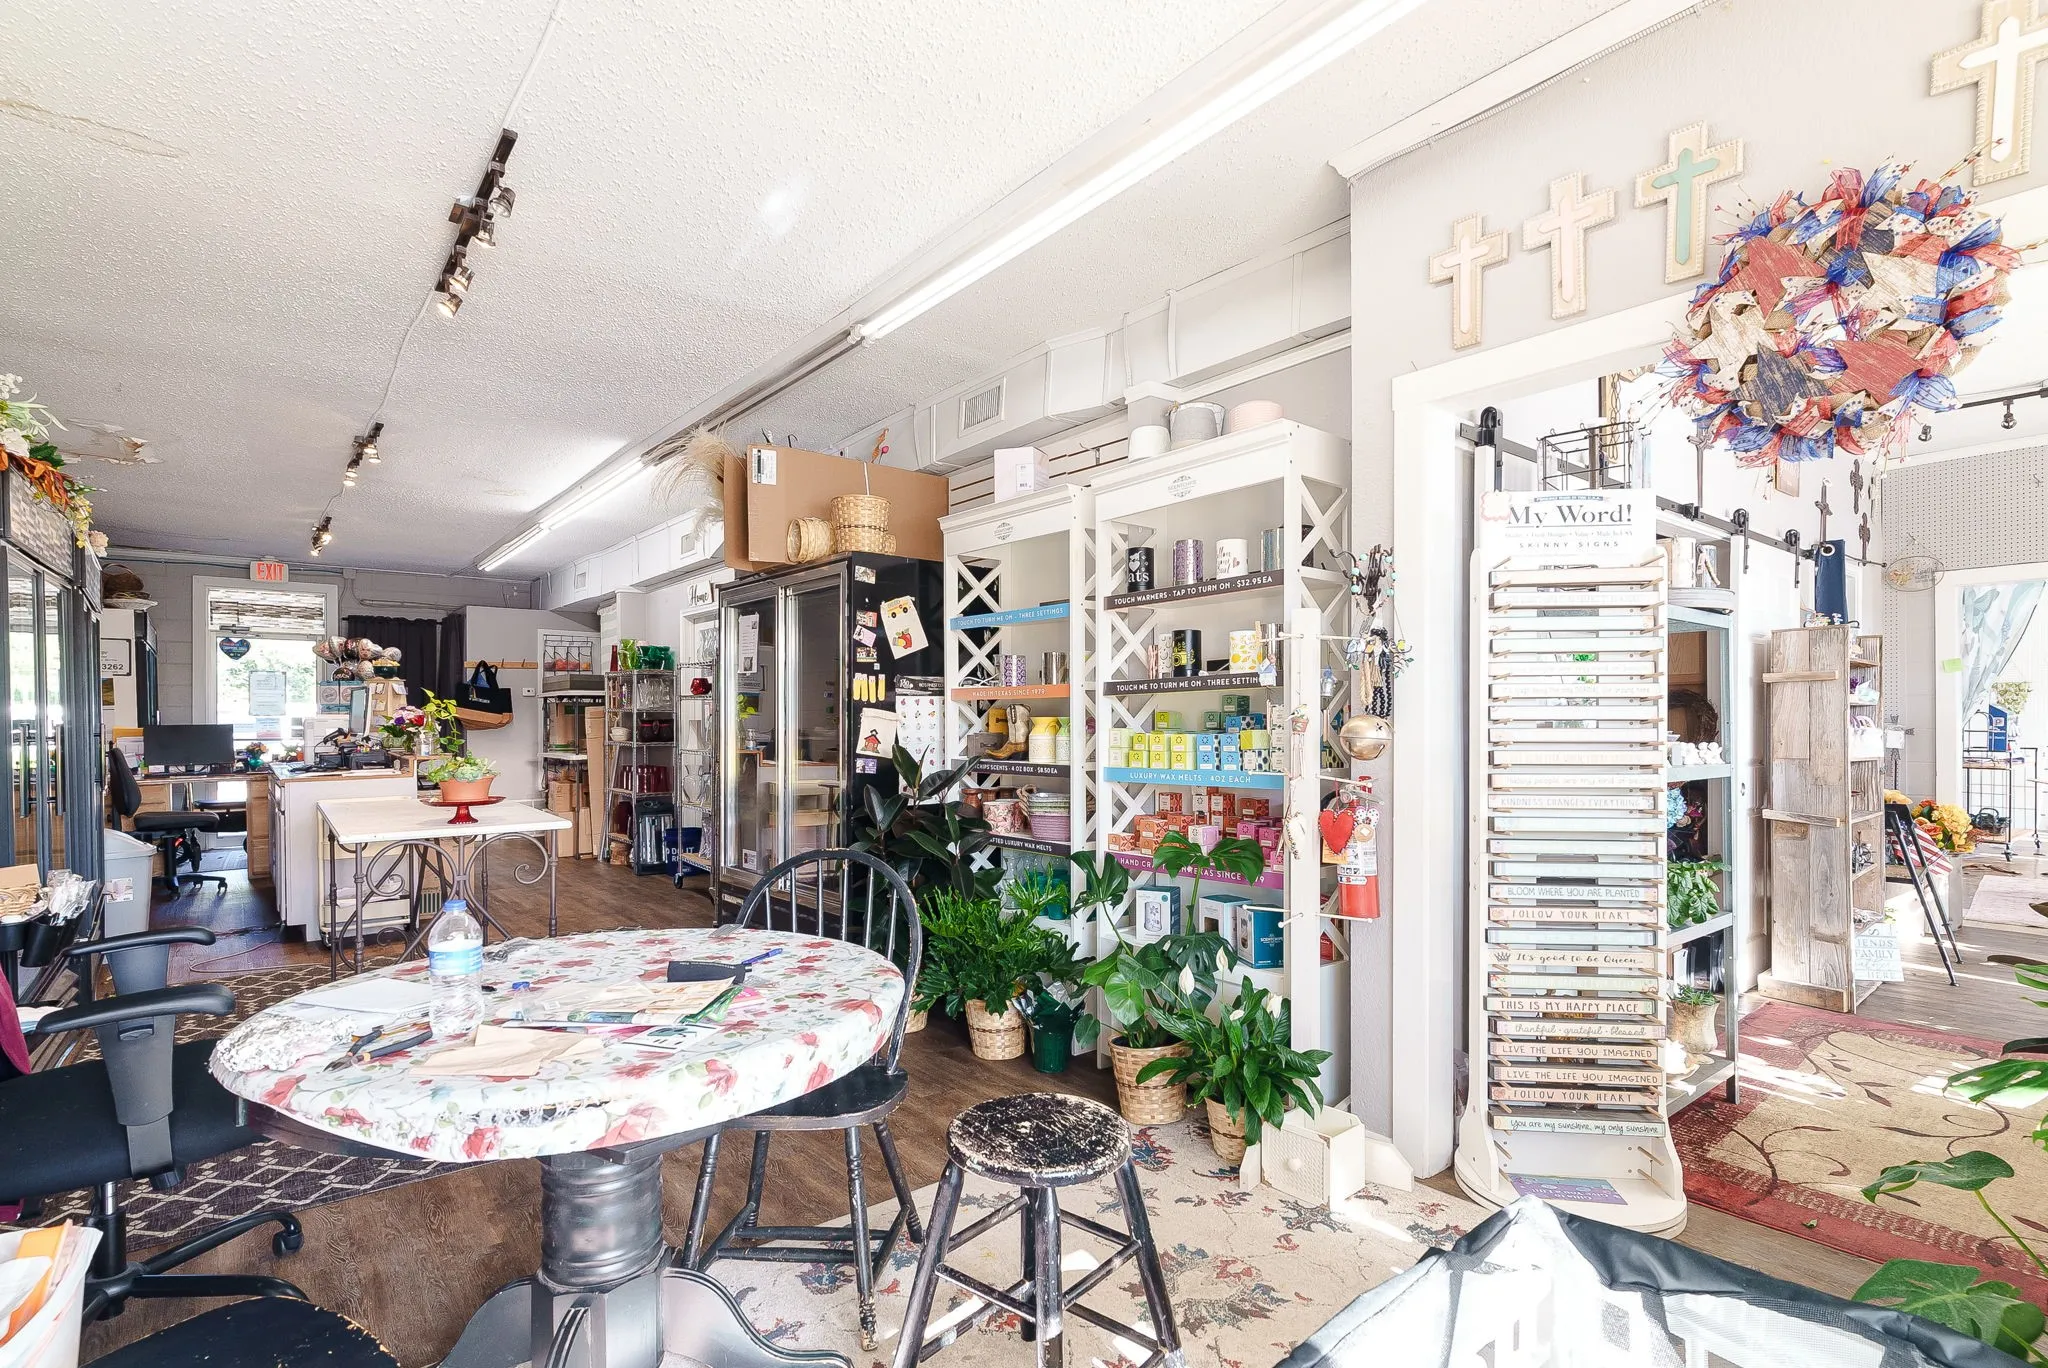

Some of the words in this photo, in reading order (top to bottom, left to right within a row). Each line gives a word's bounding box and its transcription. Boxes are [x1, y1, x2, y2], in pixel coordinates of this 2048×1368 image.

[1508, 505, 1547, 528] My
[1556, 504, 1632, 524] Word!
[256, 562, 284, 580] EXIT
[1128, 572, 1150, 582] ats
[1114, 597, 1135, 605] TOUCH
[1136, 592, 1168, 602] WARMERS
[1172, 589, 1186, 597] TAP
[1187, 587, 1196, 595] TO
[1198, 584, 1218, 594] TURN
[1220, 582, 1230, 590] ON
[1236, 578, 1262, 588] $32.95
[1263, 576, 1272, 584] EA
[1036, 608, 1064, 616] SETTINGS
[1500, 797, 1544, 806] KINDNESS
[1546, 798, 1585, 807] CHANGES
[1588, 798, 1640, 807] EVERYTHING
[1120, 857, 1139, 867] HAND
[1217, 870, 1242, 880] SINCE
[1508, 887, 1536, 896] BLOOM
[1538, 888, 1564, 896] WHERE
[1566, 888, 1584, 898] YOU
[1587, 888, 1602, 897] ARE
[1605, 889, 1640, 898] PLANTED
[1512, 910, 1553, 918] FOLLOW
[1560, 910, 1588, 919] YOUR
[1595, 911, 1631, 920] HEART
[1516, 953, 1535, 961] It's
[1540, 953, 1567, 965] good
[1570, 954, 1583, 962] to
[1586, 954, 1598, 963] be
[1500, 1000, 1524, 1010] THIS
[1529, 1001, 1540, 1010] IS
[1545, 1001, 1560, 1010] MY
[1566, 1002, 1600, 1012] HAPPY
[1606, 1003, 1638, 1012] PLACE
[1515, 1023, 1556, 1036] thankful
[1564, 1026, 1602, 1038] grateful
[1610, 1027, 1646, 1036] blessed
[1502, 1045, 1525, 1054] LIVE
[1530, 1046, 1547, 1054] THE
[1552, 1046, 1572, 1055] LIFE
[1578, 1047, 1598, 1057] YOU
[1603, 1048, 1652, 1058] IMAGINED
[1507, 1070, 1530, 1079] LIVE
[1535, 1071, 1551, 1080] THE
[1556, 1072, 1576, 1080] LIFE
[1582, 1073, 1603, 1082] YOU
[1608, 1074, 1658, 1083] IMAGINED
[1514, 1090, 1554, 1099] FOLLOW
[1562, 1092, 1589, 1100] YOUR
[1596, 1093, 1632, 1102] HEART
[1511, 1119, 1527, 1130] You
[1544, 1122, 1556, 1132] my
[1595, 1124, 1606, 1134] my
[1608, 1124, 1624, 1135] only
[1626, 1124, 1658, 1133] sunshine
